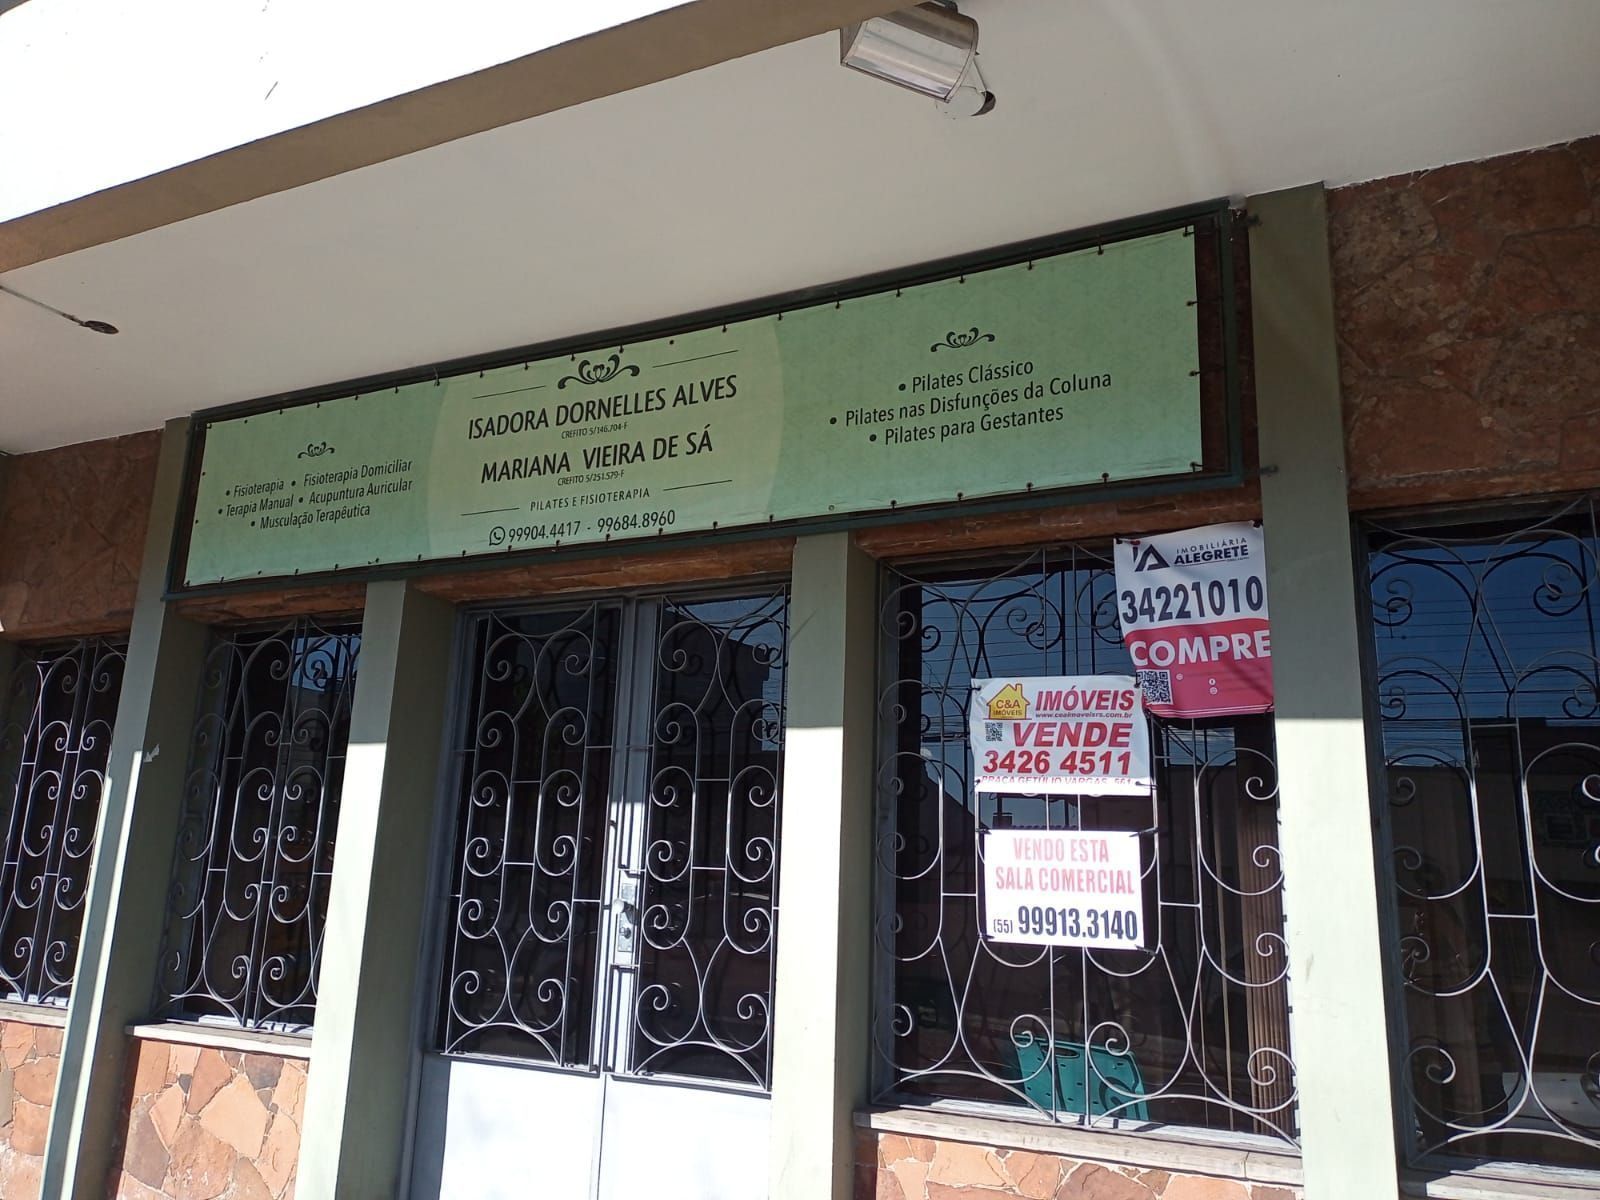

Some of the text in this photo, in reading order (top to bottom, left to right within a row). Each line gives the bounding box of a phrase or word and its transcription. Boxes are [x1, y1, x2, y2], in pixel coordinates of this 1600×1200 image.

[912, 360, 1034, 393] Pilates Clássico
[468, 374, 737, 440] ISADORA DORNELLES ALVES
[845, 373, 1112, 427] Pilates nas Disfunções da Coluna
[561, 428, 587, 439] CREFITO
[885, 406, 1064, 445] Pilates para Gestantes
[481, 423, 714, 483] MARIANA VIEIRA DE SÁ
[233, 459, 413, 498] Fisioterapia Fisioterapia Domiciliar
[558, 475, 584, 486] CREFITO
[226, 478, 413, 517] Terapia Manual Acupuntura Auricular
[530, 487, 650, 512] PILATES E FISIOTERAPIA
[260, 504, 371, 529] Musculação Terapêutica
[508, 521, 581, 543] 99904.4417
[597, 509, 676, 533] 99684.8960
[1174, 545, 1249, 566] ALEGRETE
[1176, 537, 1247, 554] IMOBILIÁRIA
[1121, 575, 1264, 624] 34221010
[1129, 629, 1272, 667] COMPRE
[996, 699, 1021, 709] C&A
[1035, 685, 1135, 711] IMÓVEIS
[1013, 722, 1134, 748] VENDE
[983, 750, 1131, 775] 3426 4511
[1013, 837, 1110, 863] VENDO ESTA
[995, 866, 1135, 894] SALA COMERCIAL
[993, 905, 1138, 941] (55) 99913.3140
